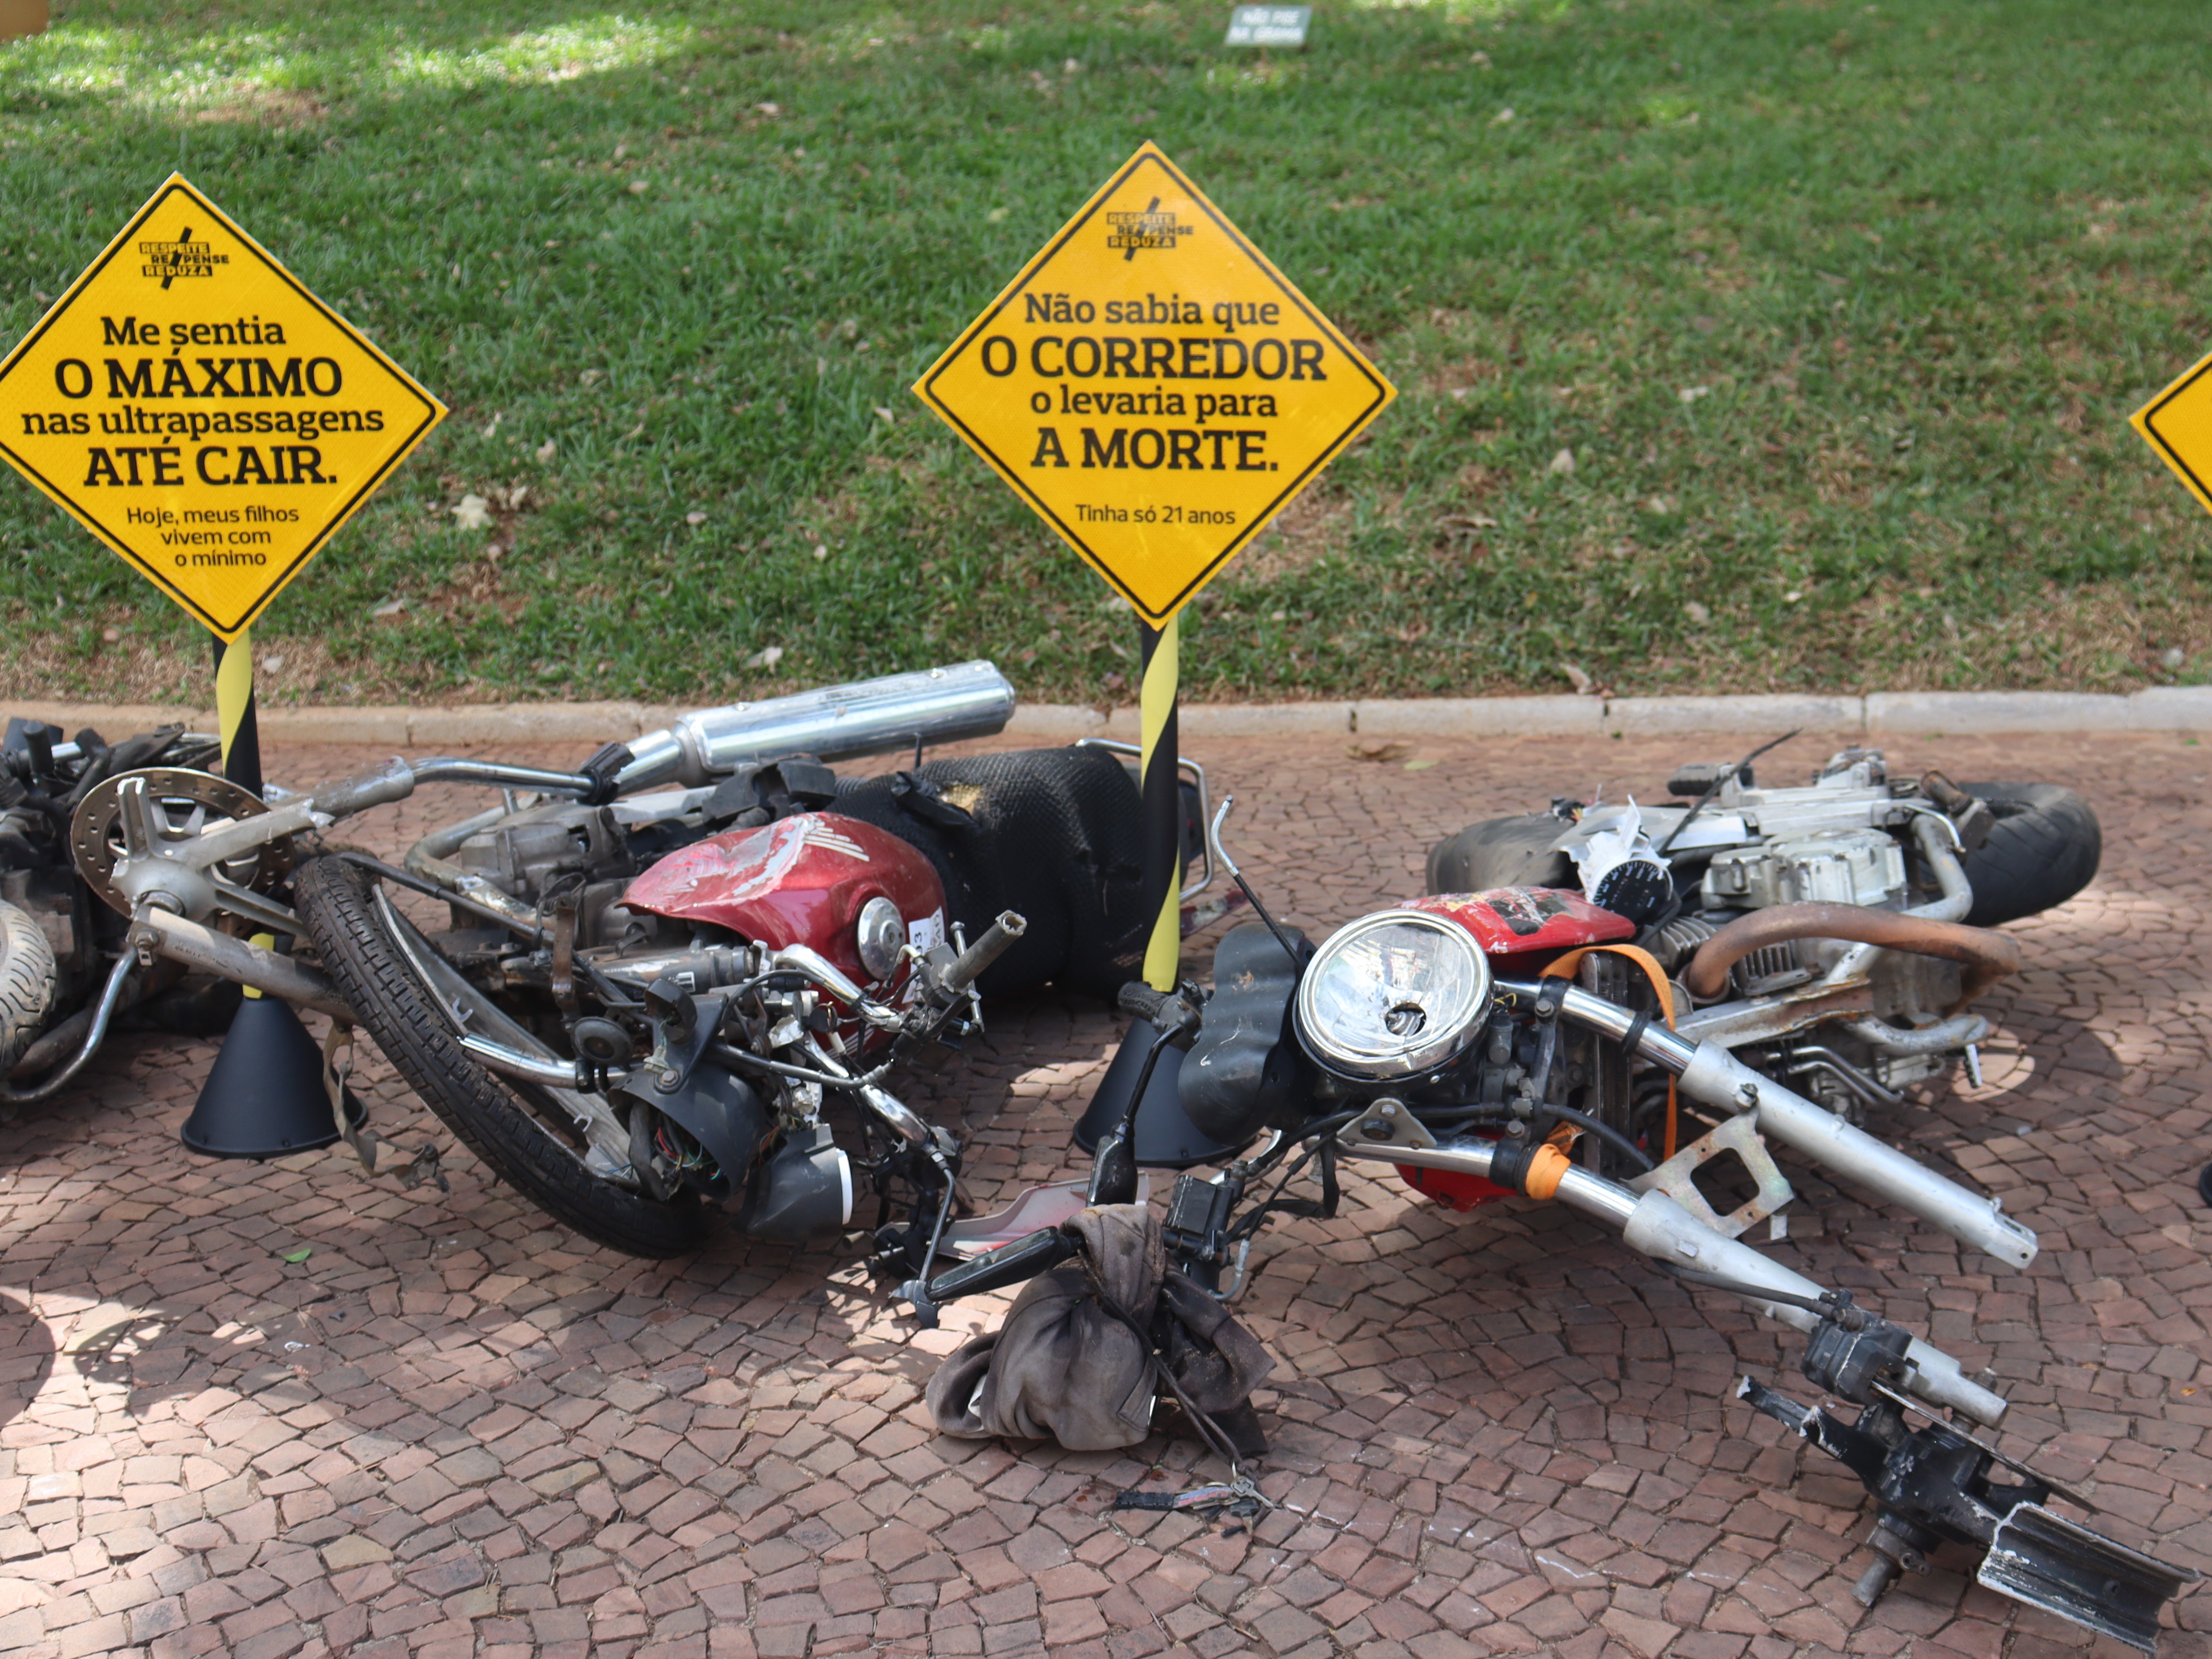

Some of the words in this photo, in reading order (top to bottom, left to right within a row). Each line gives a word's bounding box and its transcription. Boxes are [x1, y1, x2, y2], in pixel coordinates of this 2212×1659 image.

[141, 243, 208, 253] RESPEITE
[1109, 237, 1173, 247] REDUZA
[144, 266, 209, 276] REDUZA
[1025, 293, 1095, 323] Não
[1106, 294, 1203, 324] sabia
[1213, 303, 1279, 333] que
[100, 317, 160, 346] Me
[169, 315, 286, 345] sentia
[55, 358, 92, 399] O
[104, 347, 342, 398] MÁXIMO
[981, 336, 1017, 377] O
[1031, 336, 1327, 381] CORREDOR
[1031, 392, 1051, 414] o
[1060, 384, 1186, 416] levaria
[1195, 394, 1278, 424] para
[21, 413, 90, 435] nas
[98, 405, 384, 442] ultrapassagens
[83, 436, 184, 487] ATÉ
[196, 446, 337, 486] CAIR.
[1031, 428, 1069, 468] A
[1081, 428, 1278, 471] MORTE.
[127, 508, 179, 528] Hoje,
[184, 511, 240, 523] meus
[245, 506, 299, 522] filhos
[1076, 504, 1128, 522] Tinha
[1134, 505, 1156, 523] só
[1163, 506, 1181, 523] 21
[1188, 511, 1235, 524] anos
[162, 532, 223, 545] vivem
[228, 532, 271, 544] com
[175, 555, 187, 567] o
[193, 550, 266, 566] mínimo
